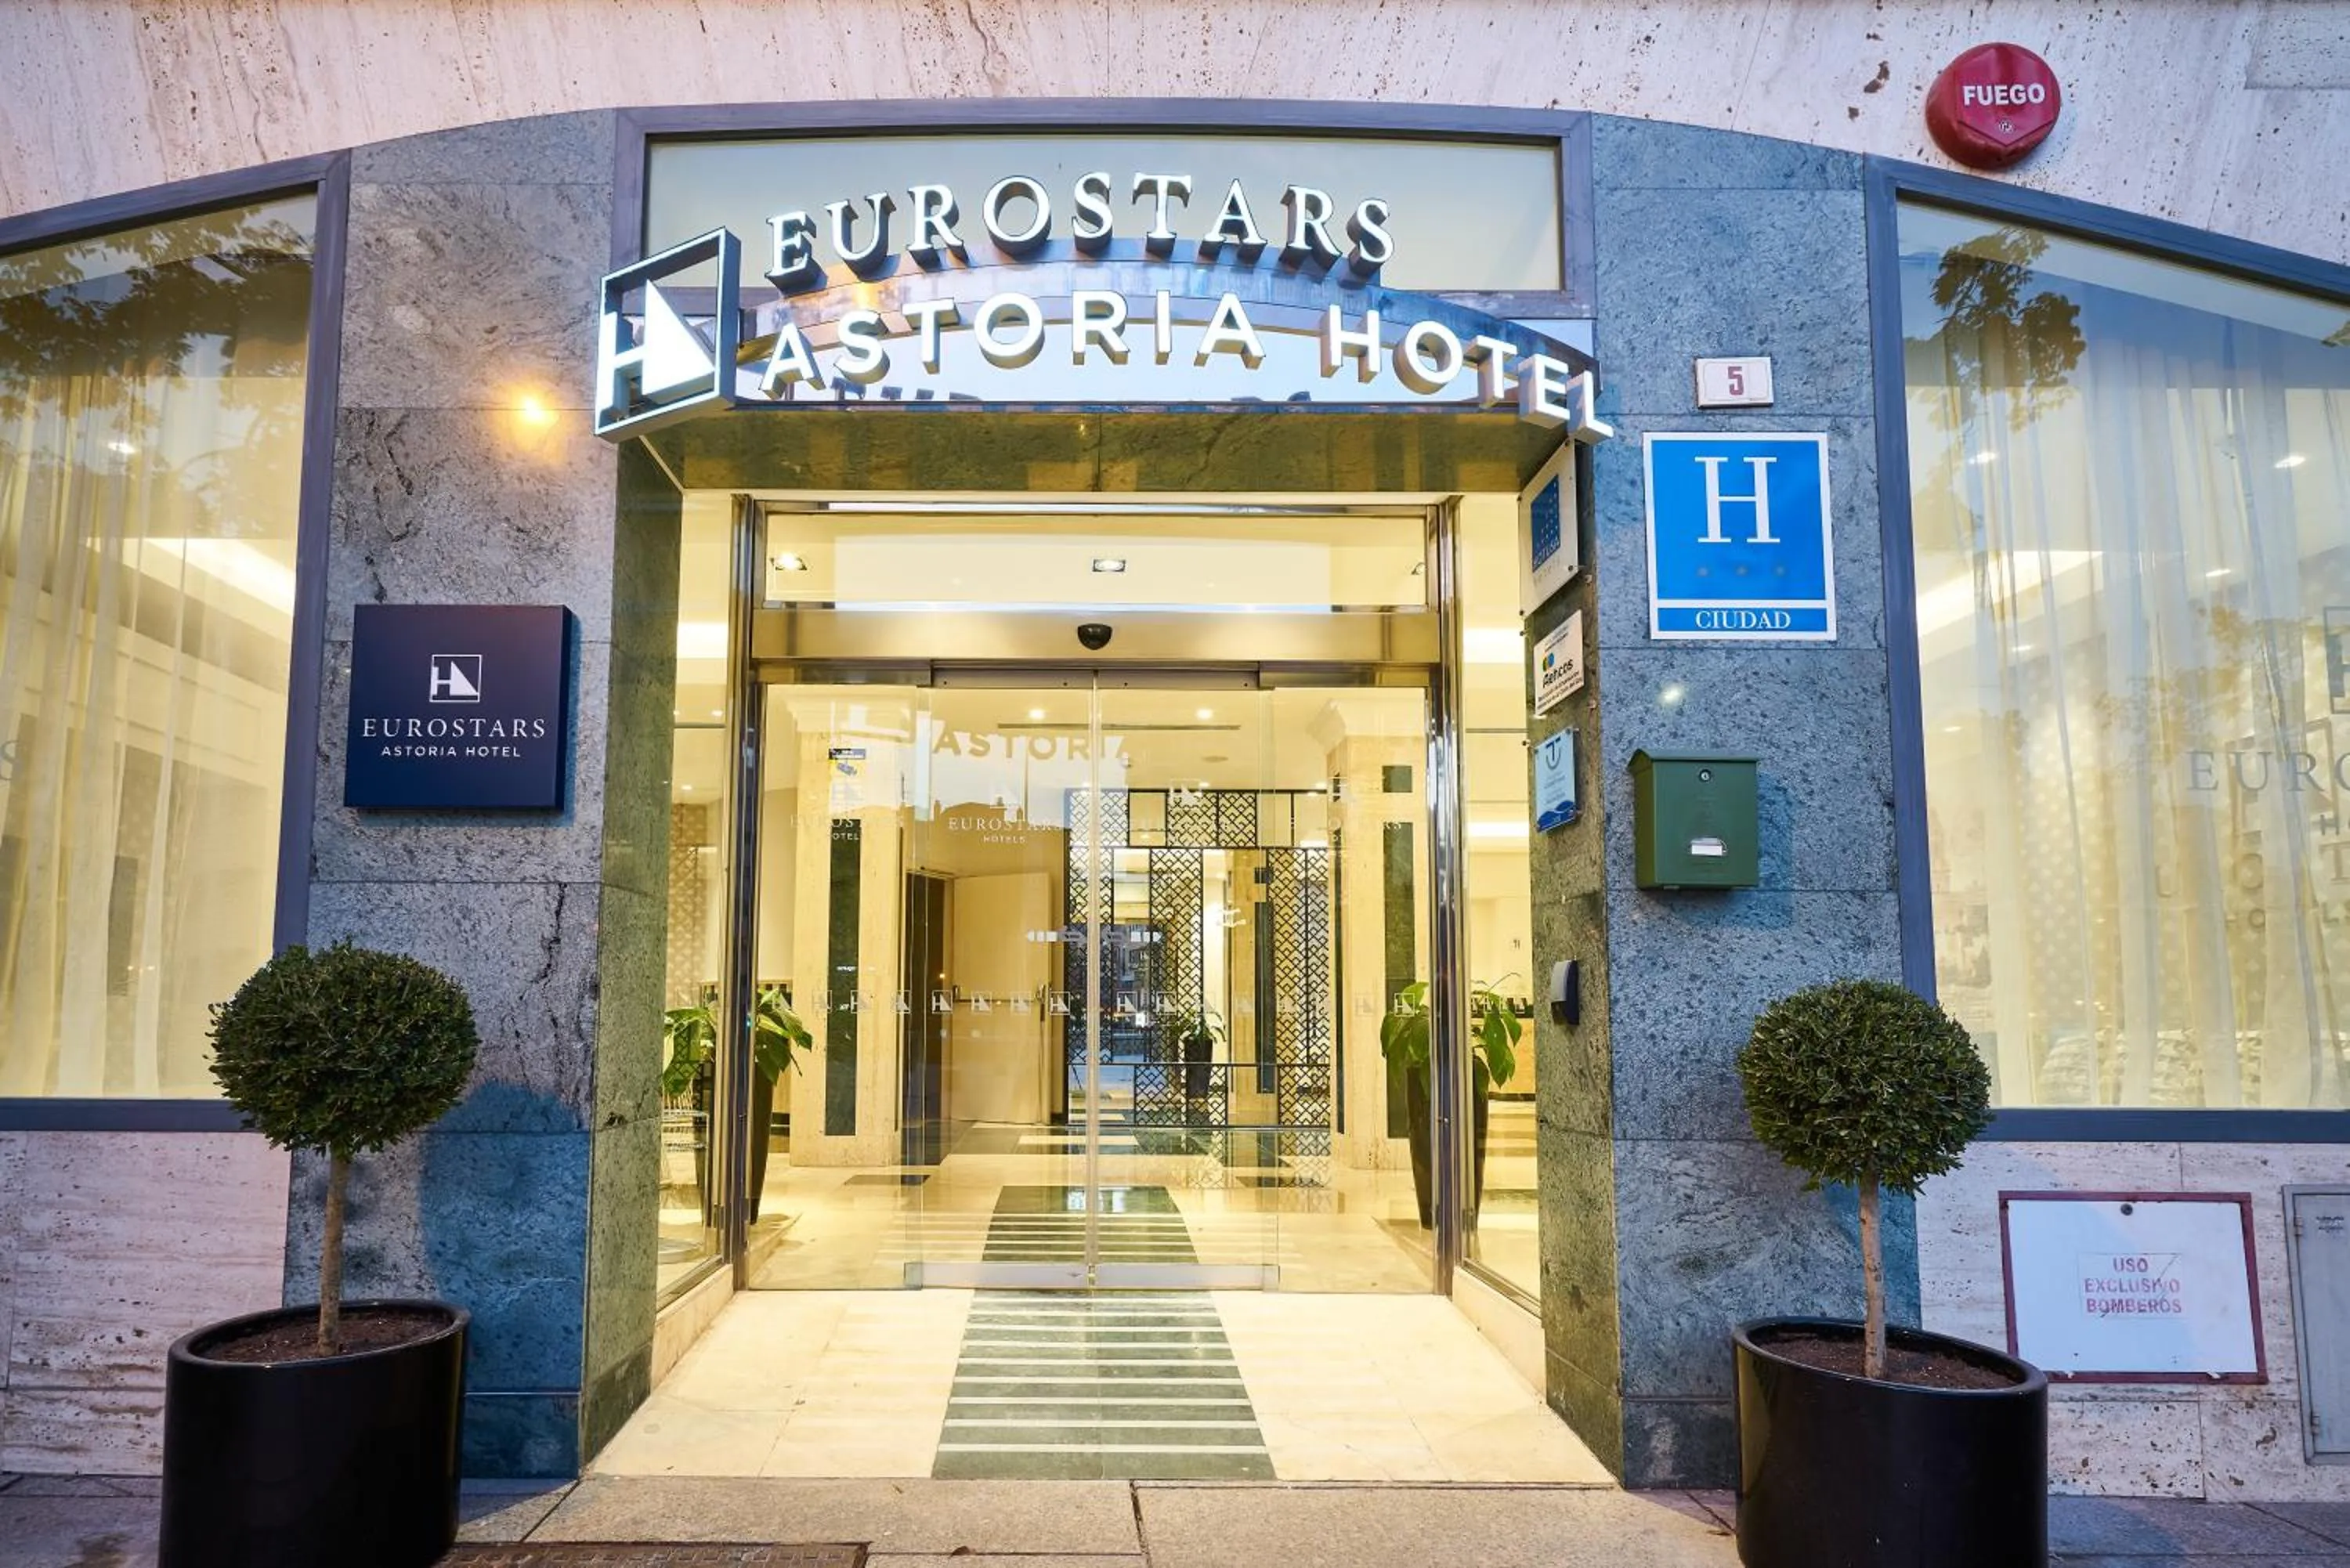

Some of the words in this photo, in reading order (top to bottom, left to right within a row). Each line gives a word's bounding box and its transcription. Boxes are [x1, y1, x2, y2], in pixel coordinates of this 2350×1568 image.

[1962, 82, 2045, 106] FUEGO
[762, 171, 1394, 288] EUROSTARS
[758, 288, 1266, 399] ASTORIA
[1321, 304, 1614, 445] HOTEL
[1726, 365, 1744, 396] 5
[1694, 456, 1781, 543] H
[1694, 610, 1791, 630] CIUDAD
[362, 718, 546, 739] EUROSTARS
[381, 746, 457, 757] ASTORIA
[465, 746, 521, 757] HOTEL
[2113, 1256, 2149, 1273] USO
[2086, 1297, 2182, 1314] BOMBEROS
